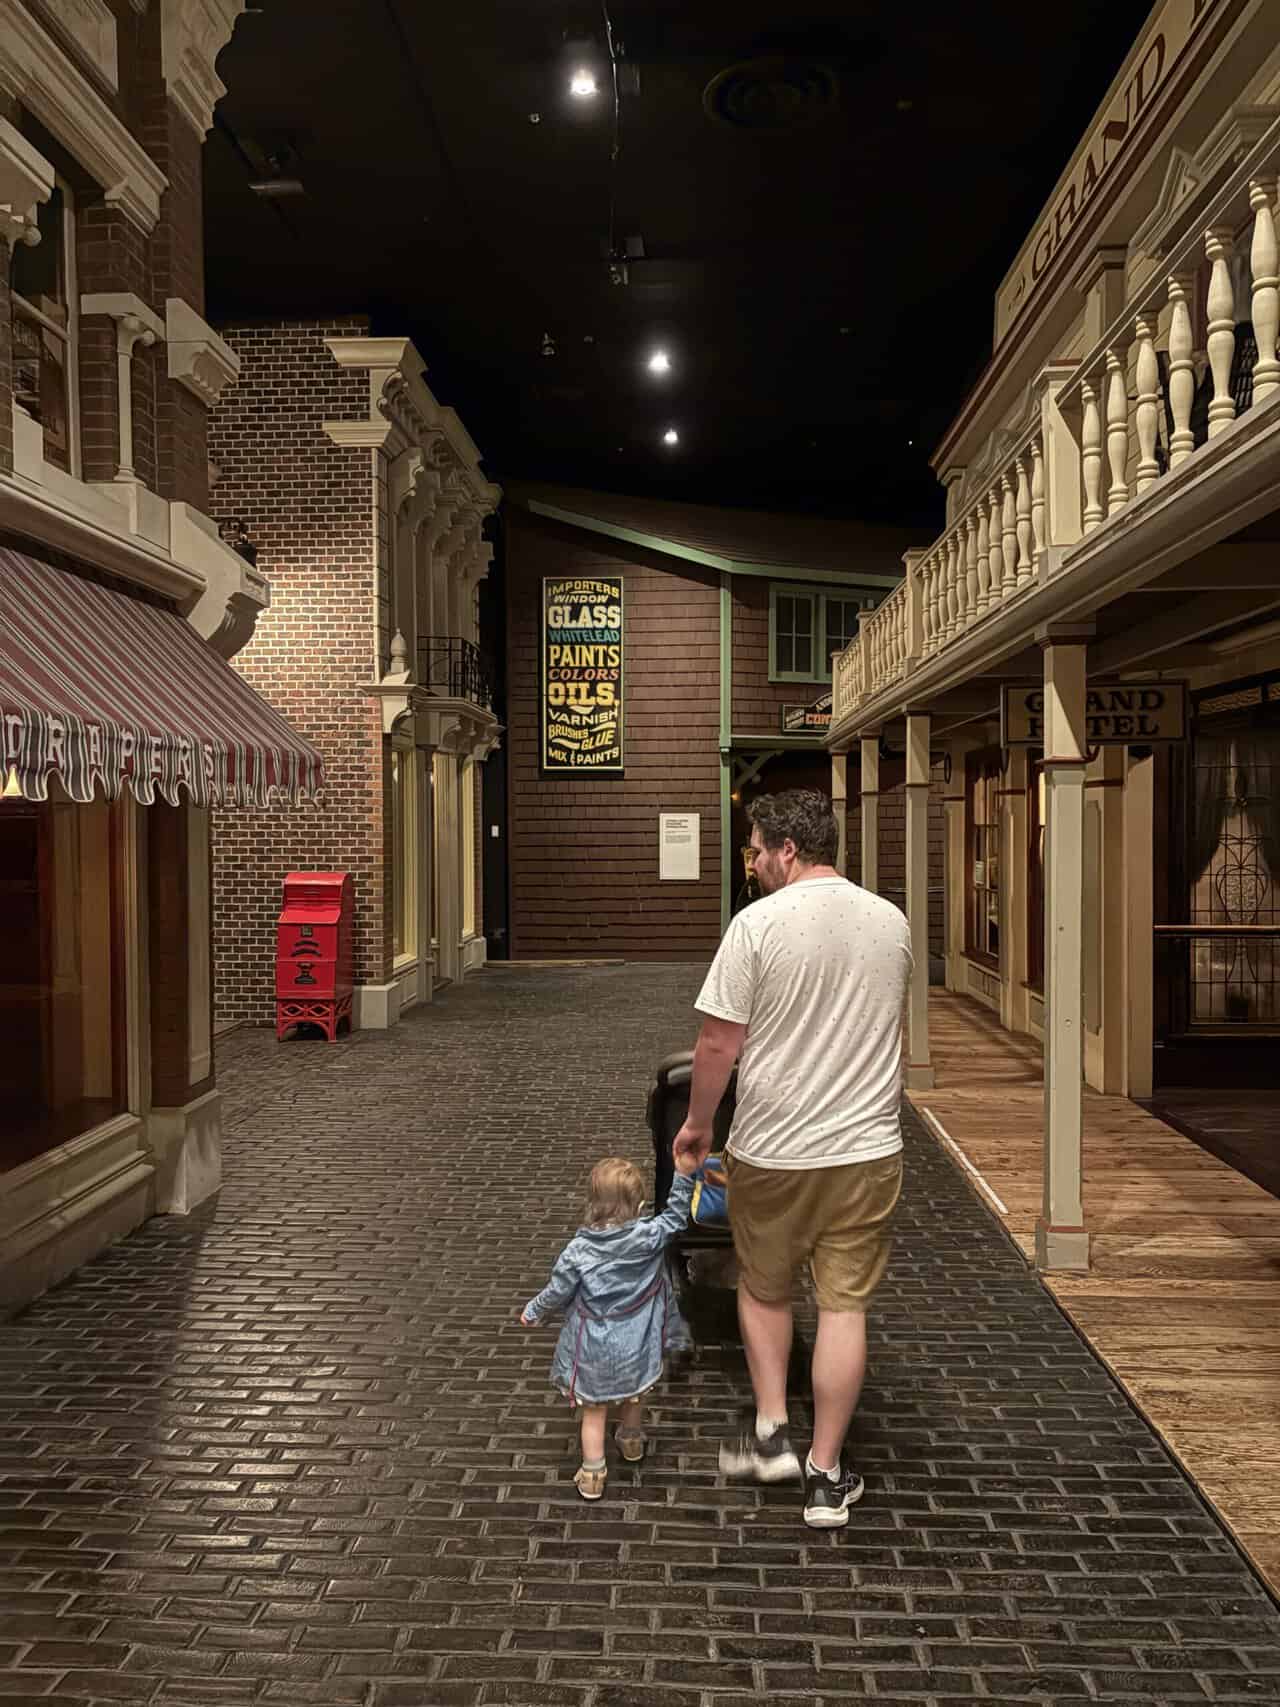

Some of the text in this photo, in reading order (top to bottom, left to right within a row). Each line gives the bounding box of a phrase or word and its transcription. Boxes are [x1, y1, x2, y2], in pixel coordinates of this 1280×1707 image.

[1031, 32, 1166, 282] GRAND
[548, 580, 620, 598] IMPORTERS
[554, 594, 609, 604] WINDOW
[548, 605, 620, 629] GLASS
[548, 644, 620, 667] PAINTS
[548, 668, 620, 681] COLORS
[1024, 689, 1164, 714] GAND
[548, 706, 618, 726] VARNISH
[1027, 714, 1160, 737] HTEL
[548, 724, 589, 739] BRUSHES
[581, 729, 615, 750] GLUE
[5, 714, 214, 778] DRAPERS
[548, 746, 568, 762] MIX
[577, 746, 620, 765] PAINTS
